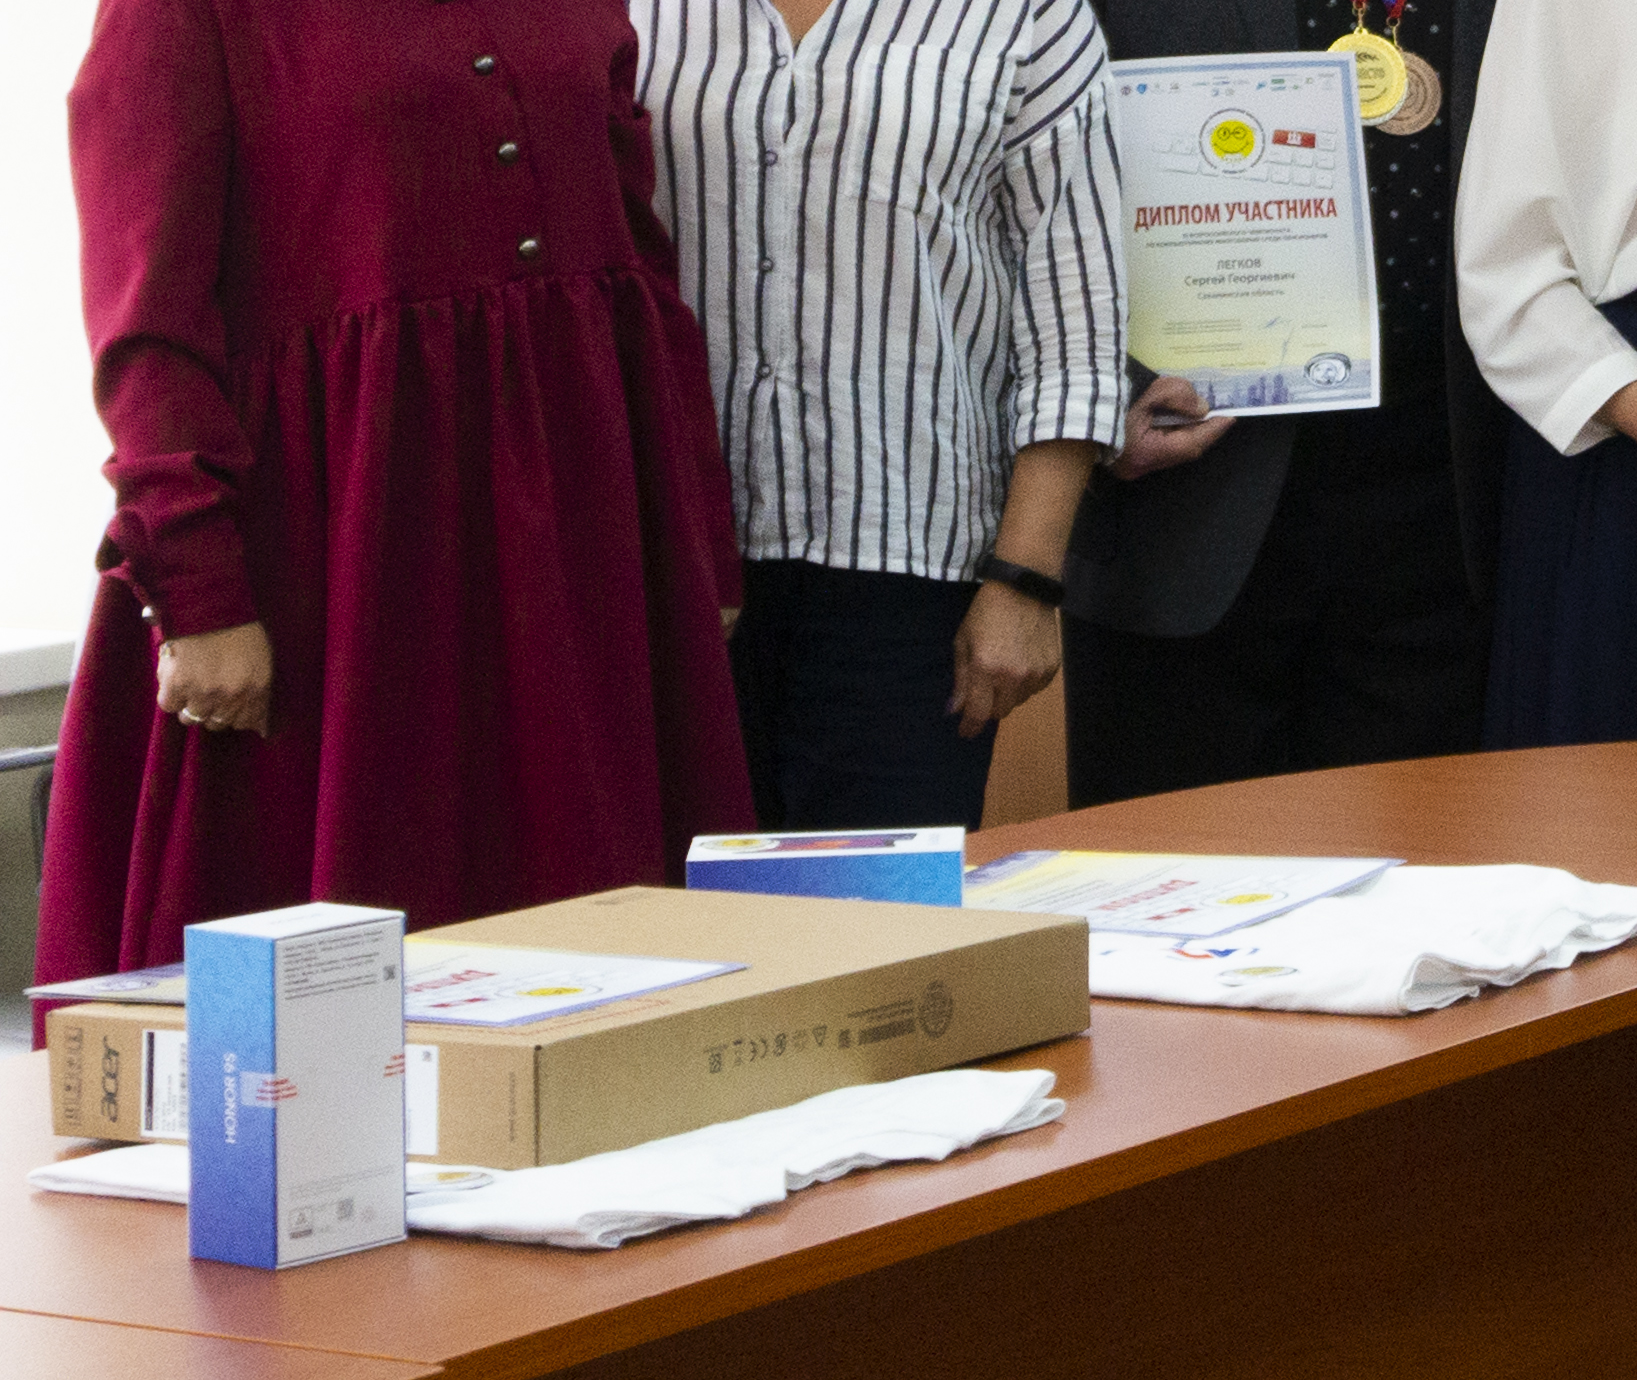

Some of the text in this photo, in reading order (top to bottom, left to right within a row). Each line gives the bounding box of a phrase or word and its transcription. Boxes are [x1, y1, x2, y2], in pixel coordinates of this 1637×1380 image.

[1133, 197, 1338, 232] ДИПЛОМ УЧАСТНИКА
[1184, 271, 1296, 288] Сергей Георгиевич
[102, 1035, 120, 1123] acer
[223, 1075, 237, 1145] HONOR
